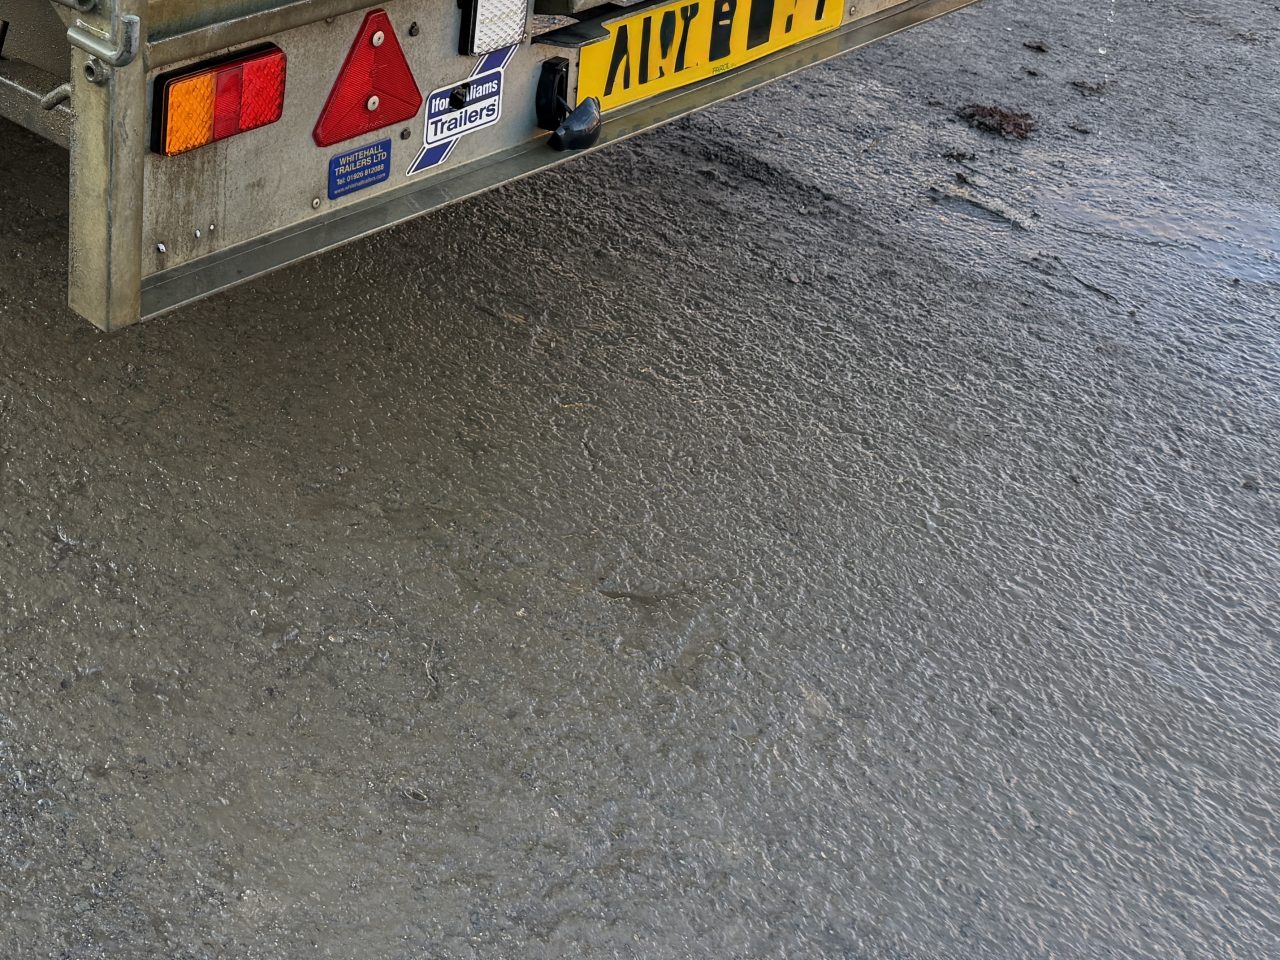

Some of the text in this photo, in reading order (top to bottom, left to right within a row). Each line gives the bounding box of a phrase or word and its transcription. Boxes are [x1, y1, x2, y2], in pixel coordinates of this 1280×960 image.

[431, 103, 496, 136] Trailers
[334, 151, 387, 177] TRAILERS LTD
[339, 144, 384, 166] WHITEHALL
